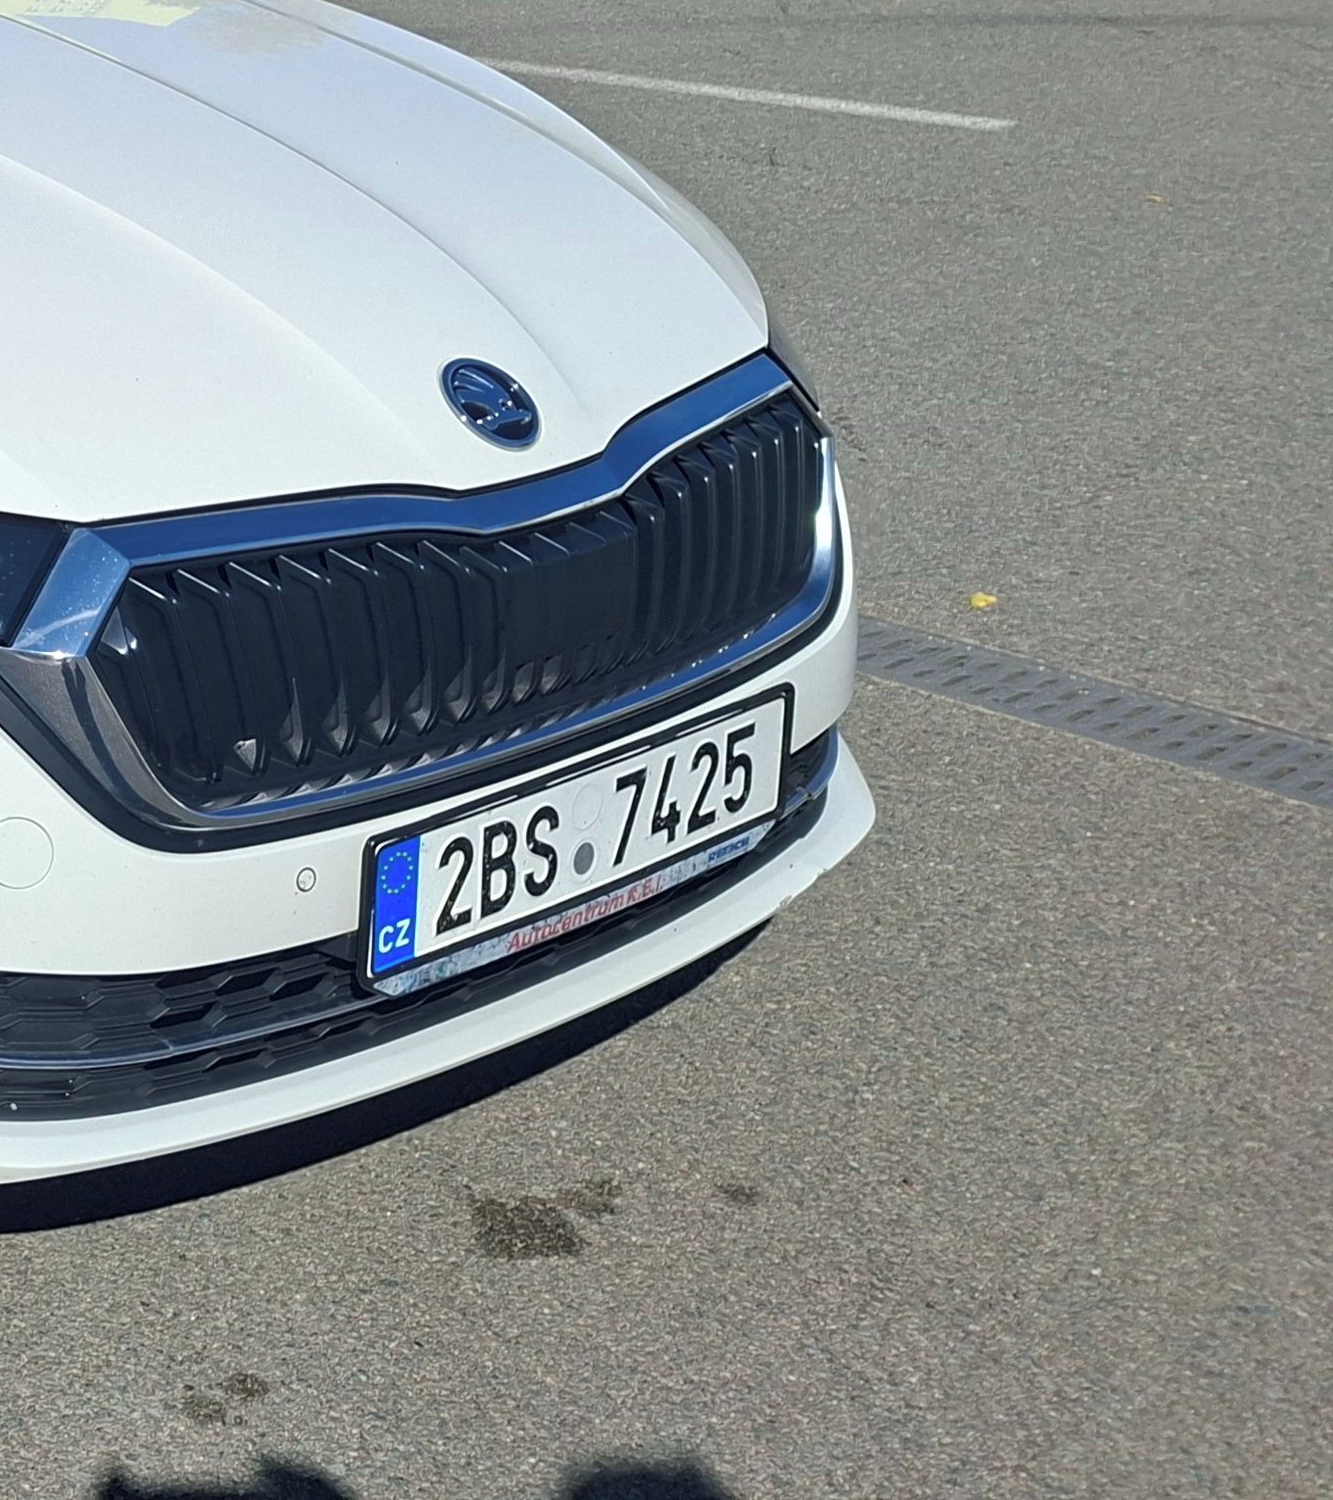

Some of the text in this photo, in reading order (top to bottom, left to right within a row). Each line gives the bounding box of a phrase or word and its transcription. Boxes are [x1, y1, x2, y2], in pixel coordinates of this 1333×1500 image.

[436, 721, 757, 936] 2BS 7425
[378, 919, 411, 954] CZ
[508, 889, 628, 953] Autocentrum
